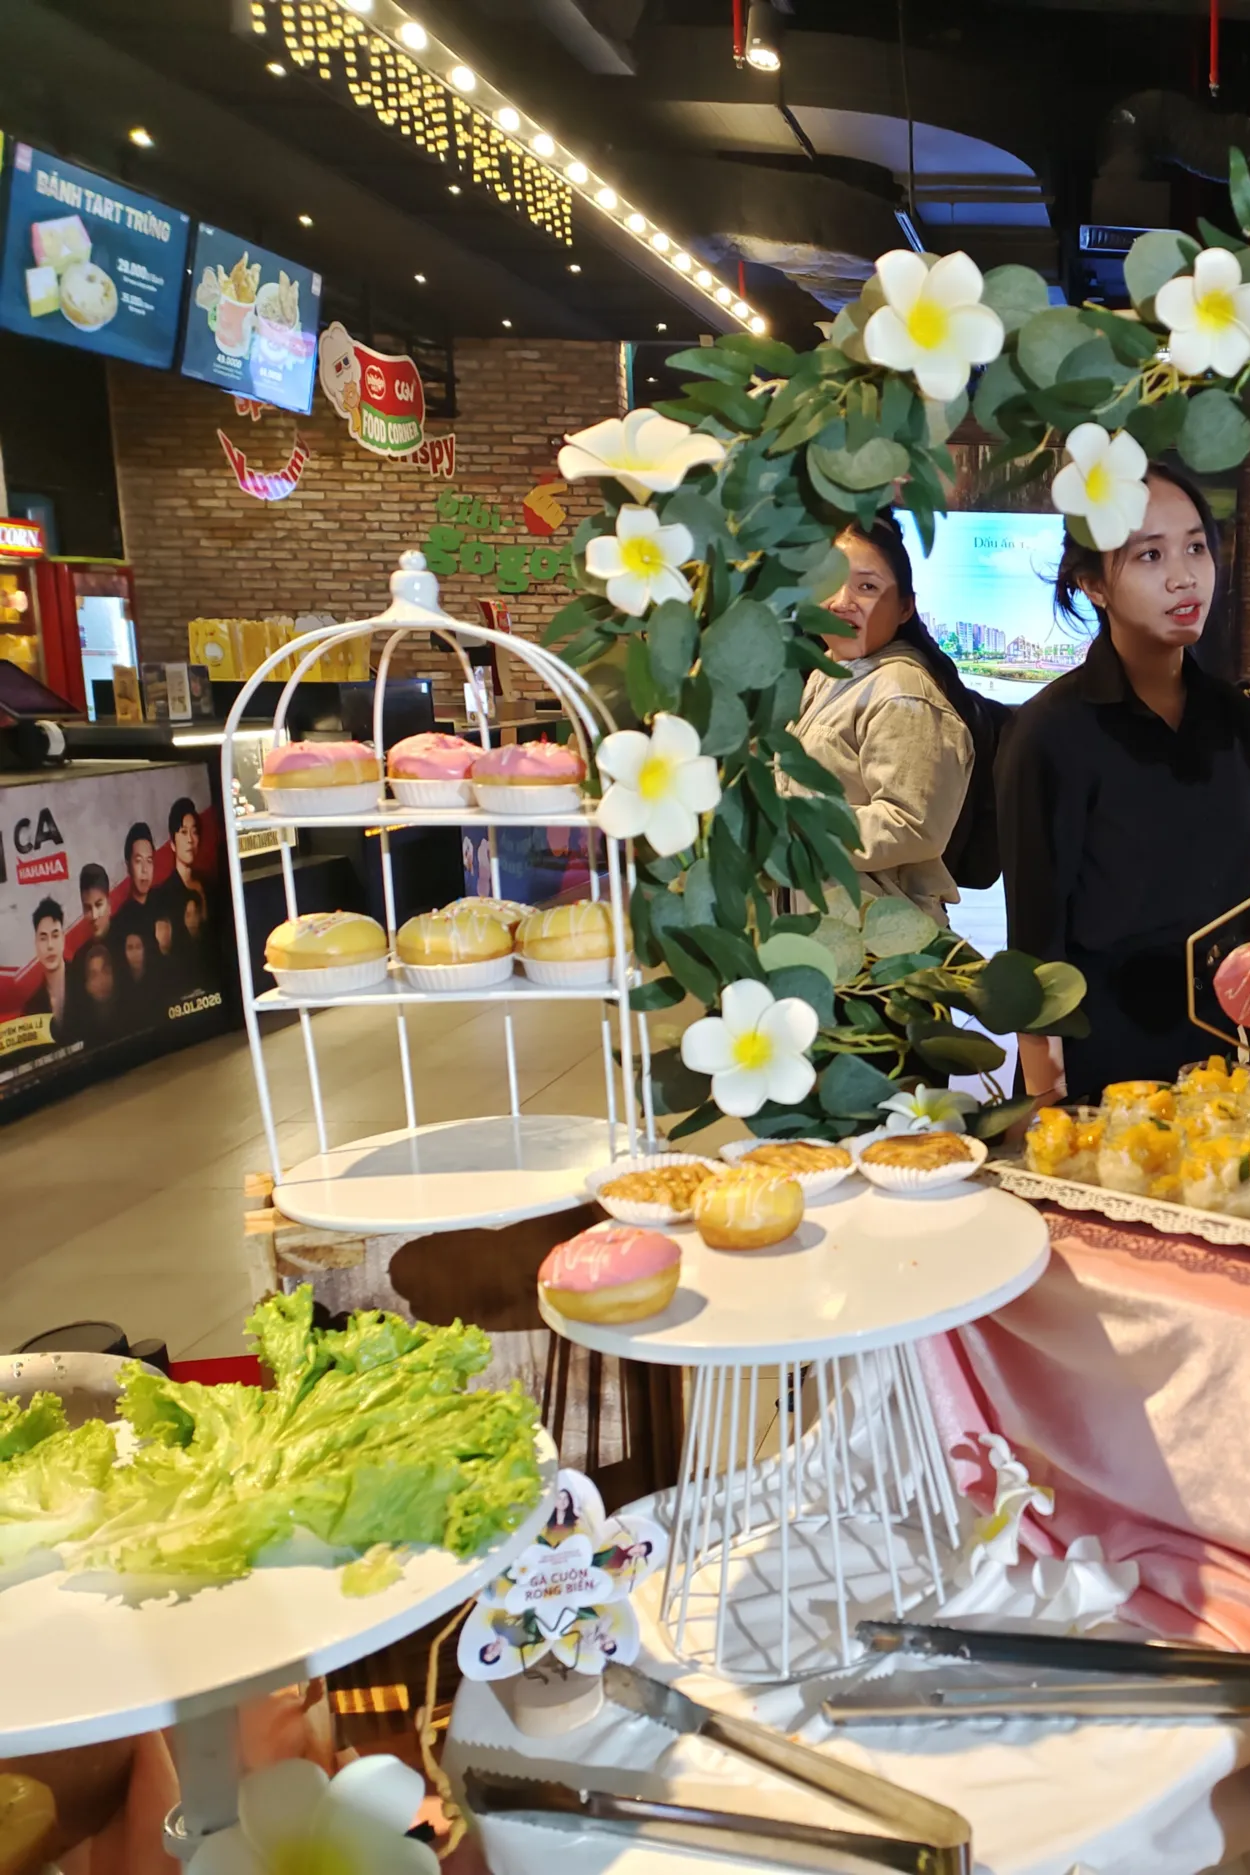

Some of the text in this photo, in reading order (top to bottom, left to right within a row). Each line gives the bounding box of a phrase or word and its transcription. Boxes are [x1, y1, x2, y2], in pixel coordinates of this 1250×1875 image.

[36, 170, 83, 208] BÁNH
[85, 188, 125, 224] TART
[394, 379, 416, 402] CGV
[362, 408, 420, 445] FOOD CORNER
[387, 435, 455, 478] ispy
[13, 807, 64, 855] CA
[525, 1583, 562, 1601] RONG
